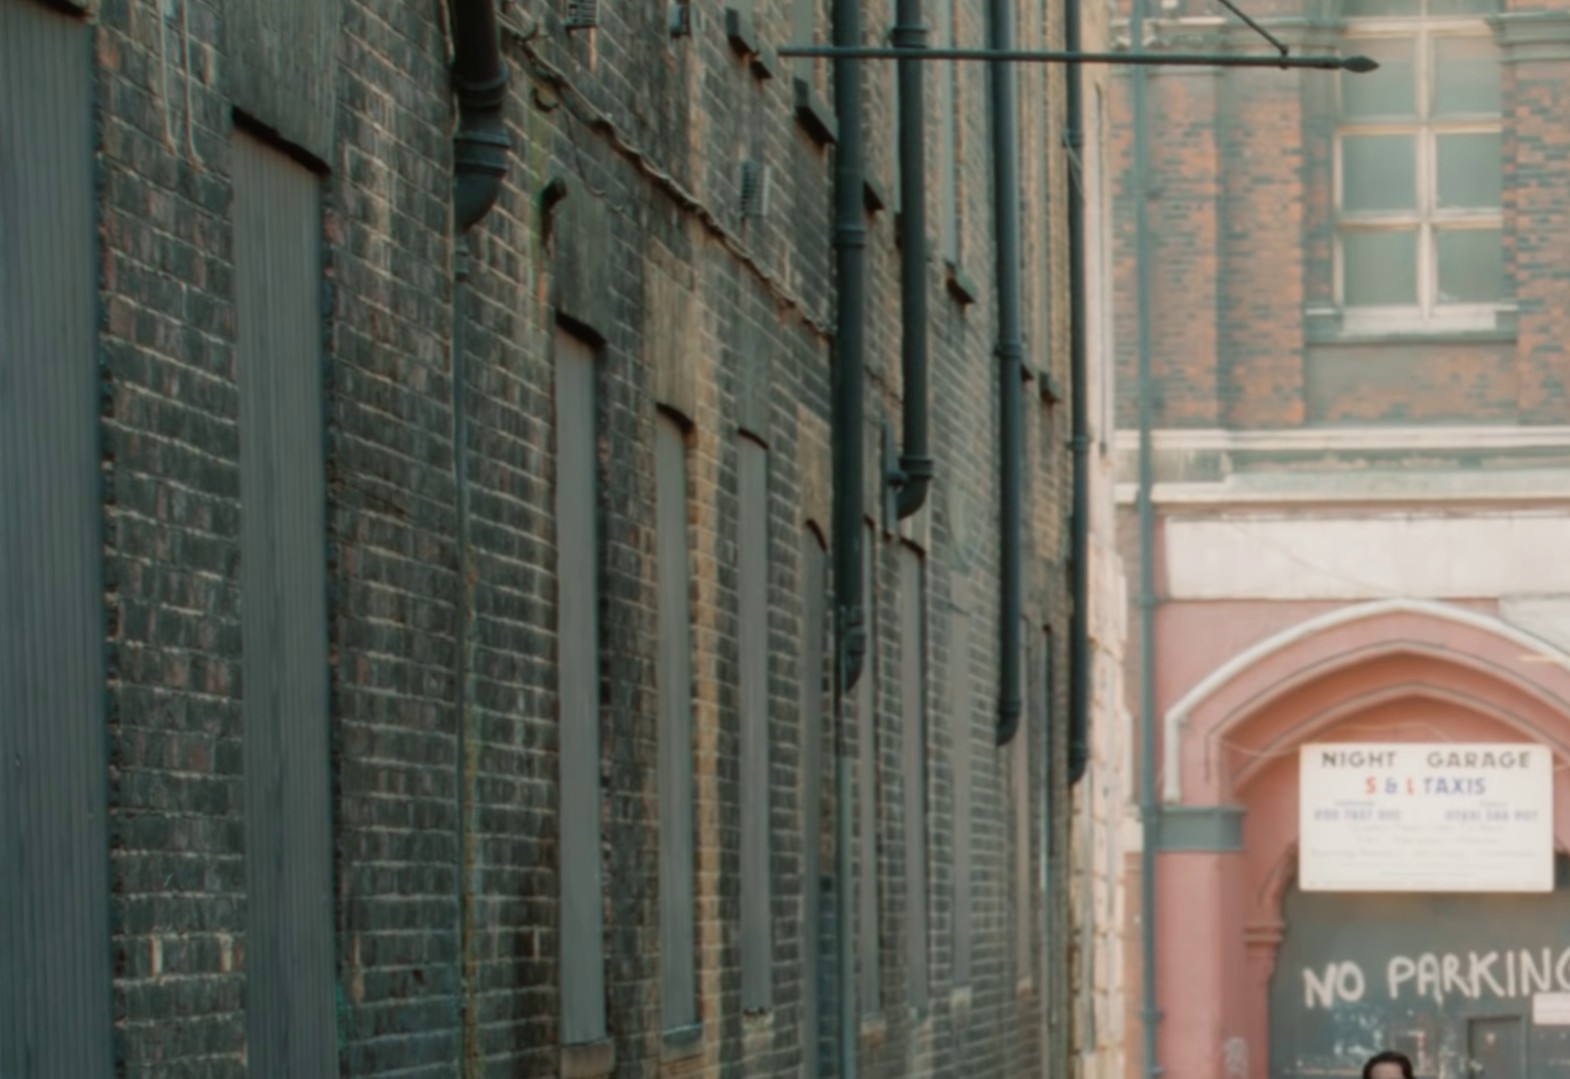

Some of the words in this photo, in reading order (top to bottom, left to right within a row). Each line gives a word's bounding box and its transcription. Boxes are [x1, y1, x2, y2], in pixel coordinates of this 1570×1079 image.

[1321, 751, 1398, 769] NIGHT
[1426, 751, 1532, 769] GARAGE
[1365, 777, 1377, 795] S
[1385, 777, 1398, 795] &
[1406, 777, 1415, 795] L
[1424, 777, 1487, 795] TAXIS
[1303, 960, 1366, 1009] NO
